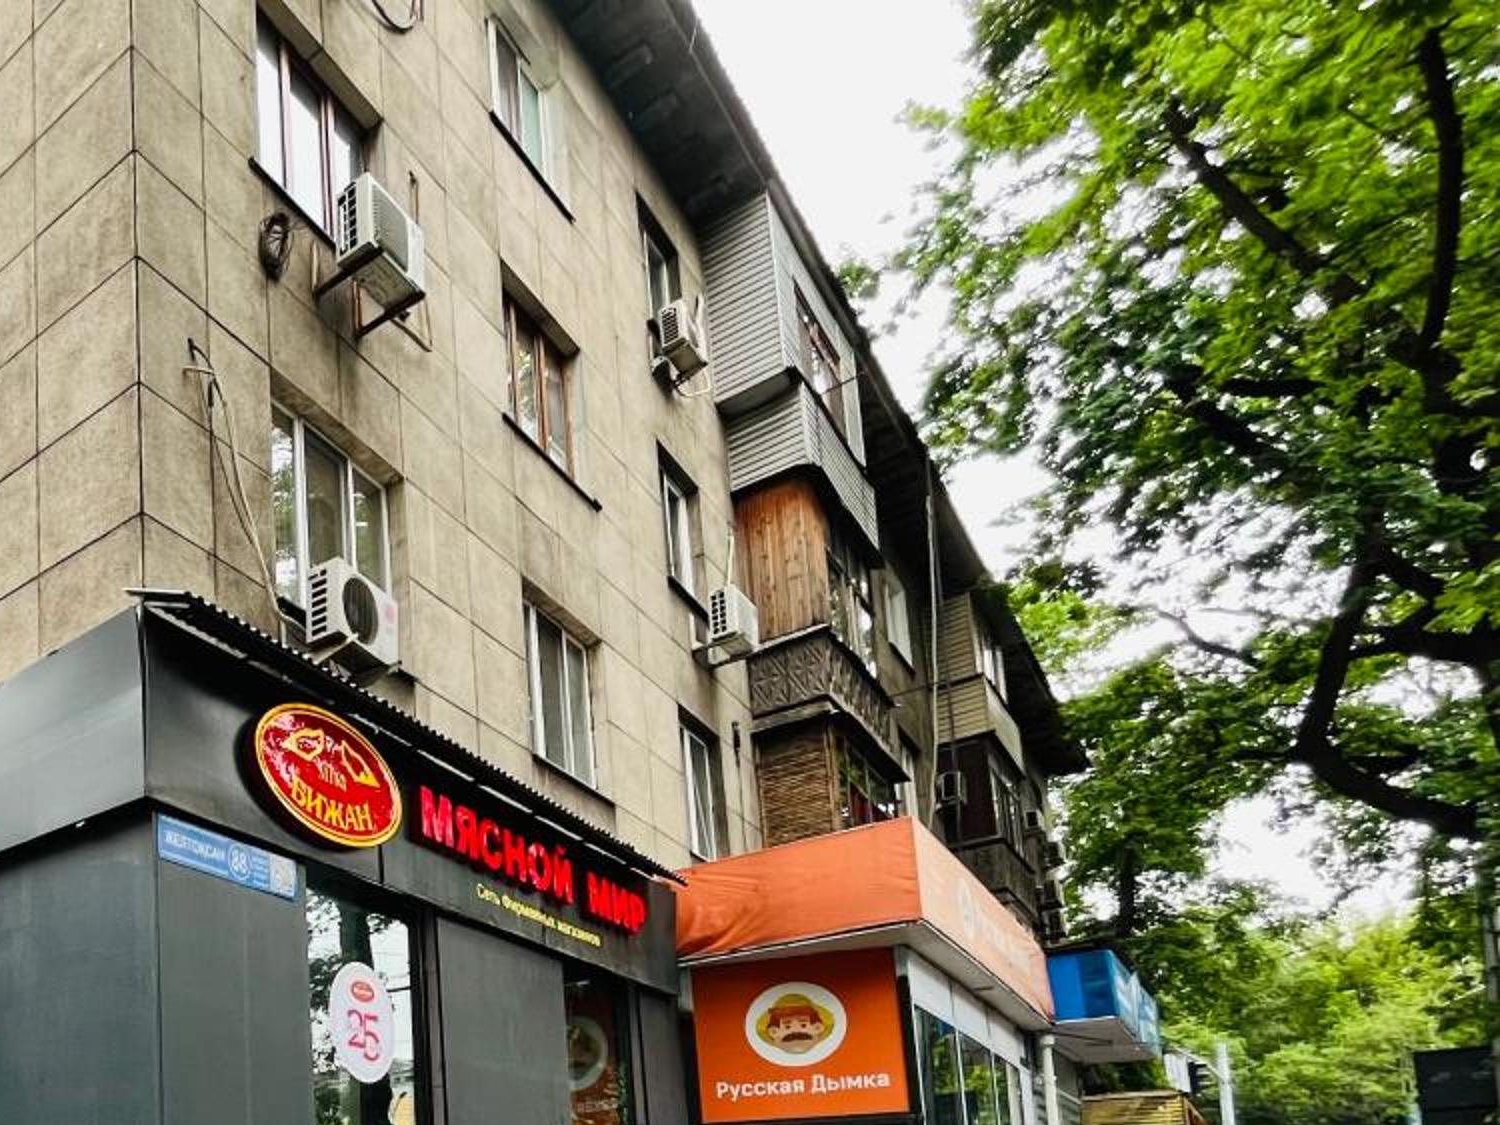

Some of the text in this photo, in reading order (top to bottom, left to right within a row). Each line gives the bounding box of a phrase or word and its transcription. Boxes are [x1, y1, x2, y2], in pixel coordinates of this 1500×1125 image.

[291, 776, 373, 831] БИЖАН
[420, 785, 649, 935] МЯСНОЙ МИР
[347, 1008, 380, 1061] 25
[715, 1072, 891, 1101] Русская Дымка
